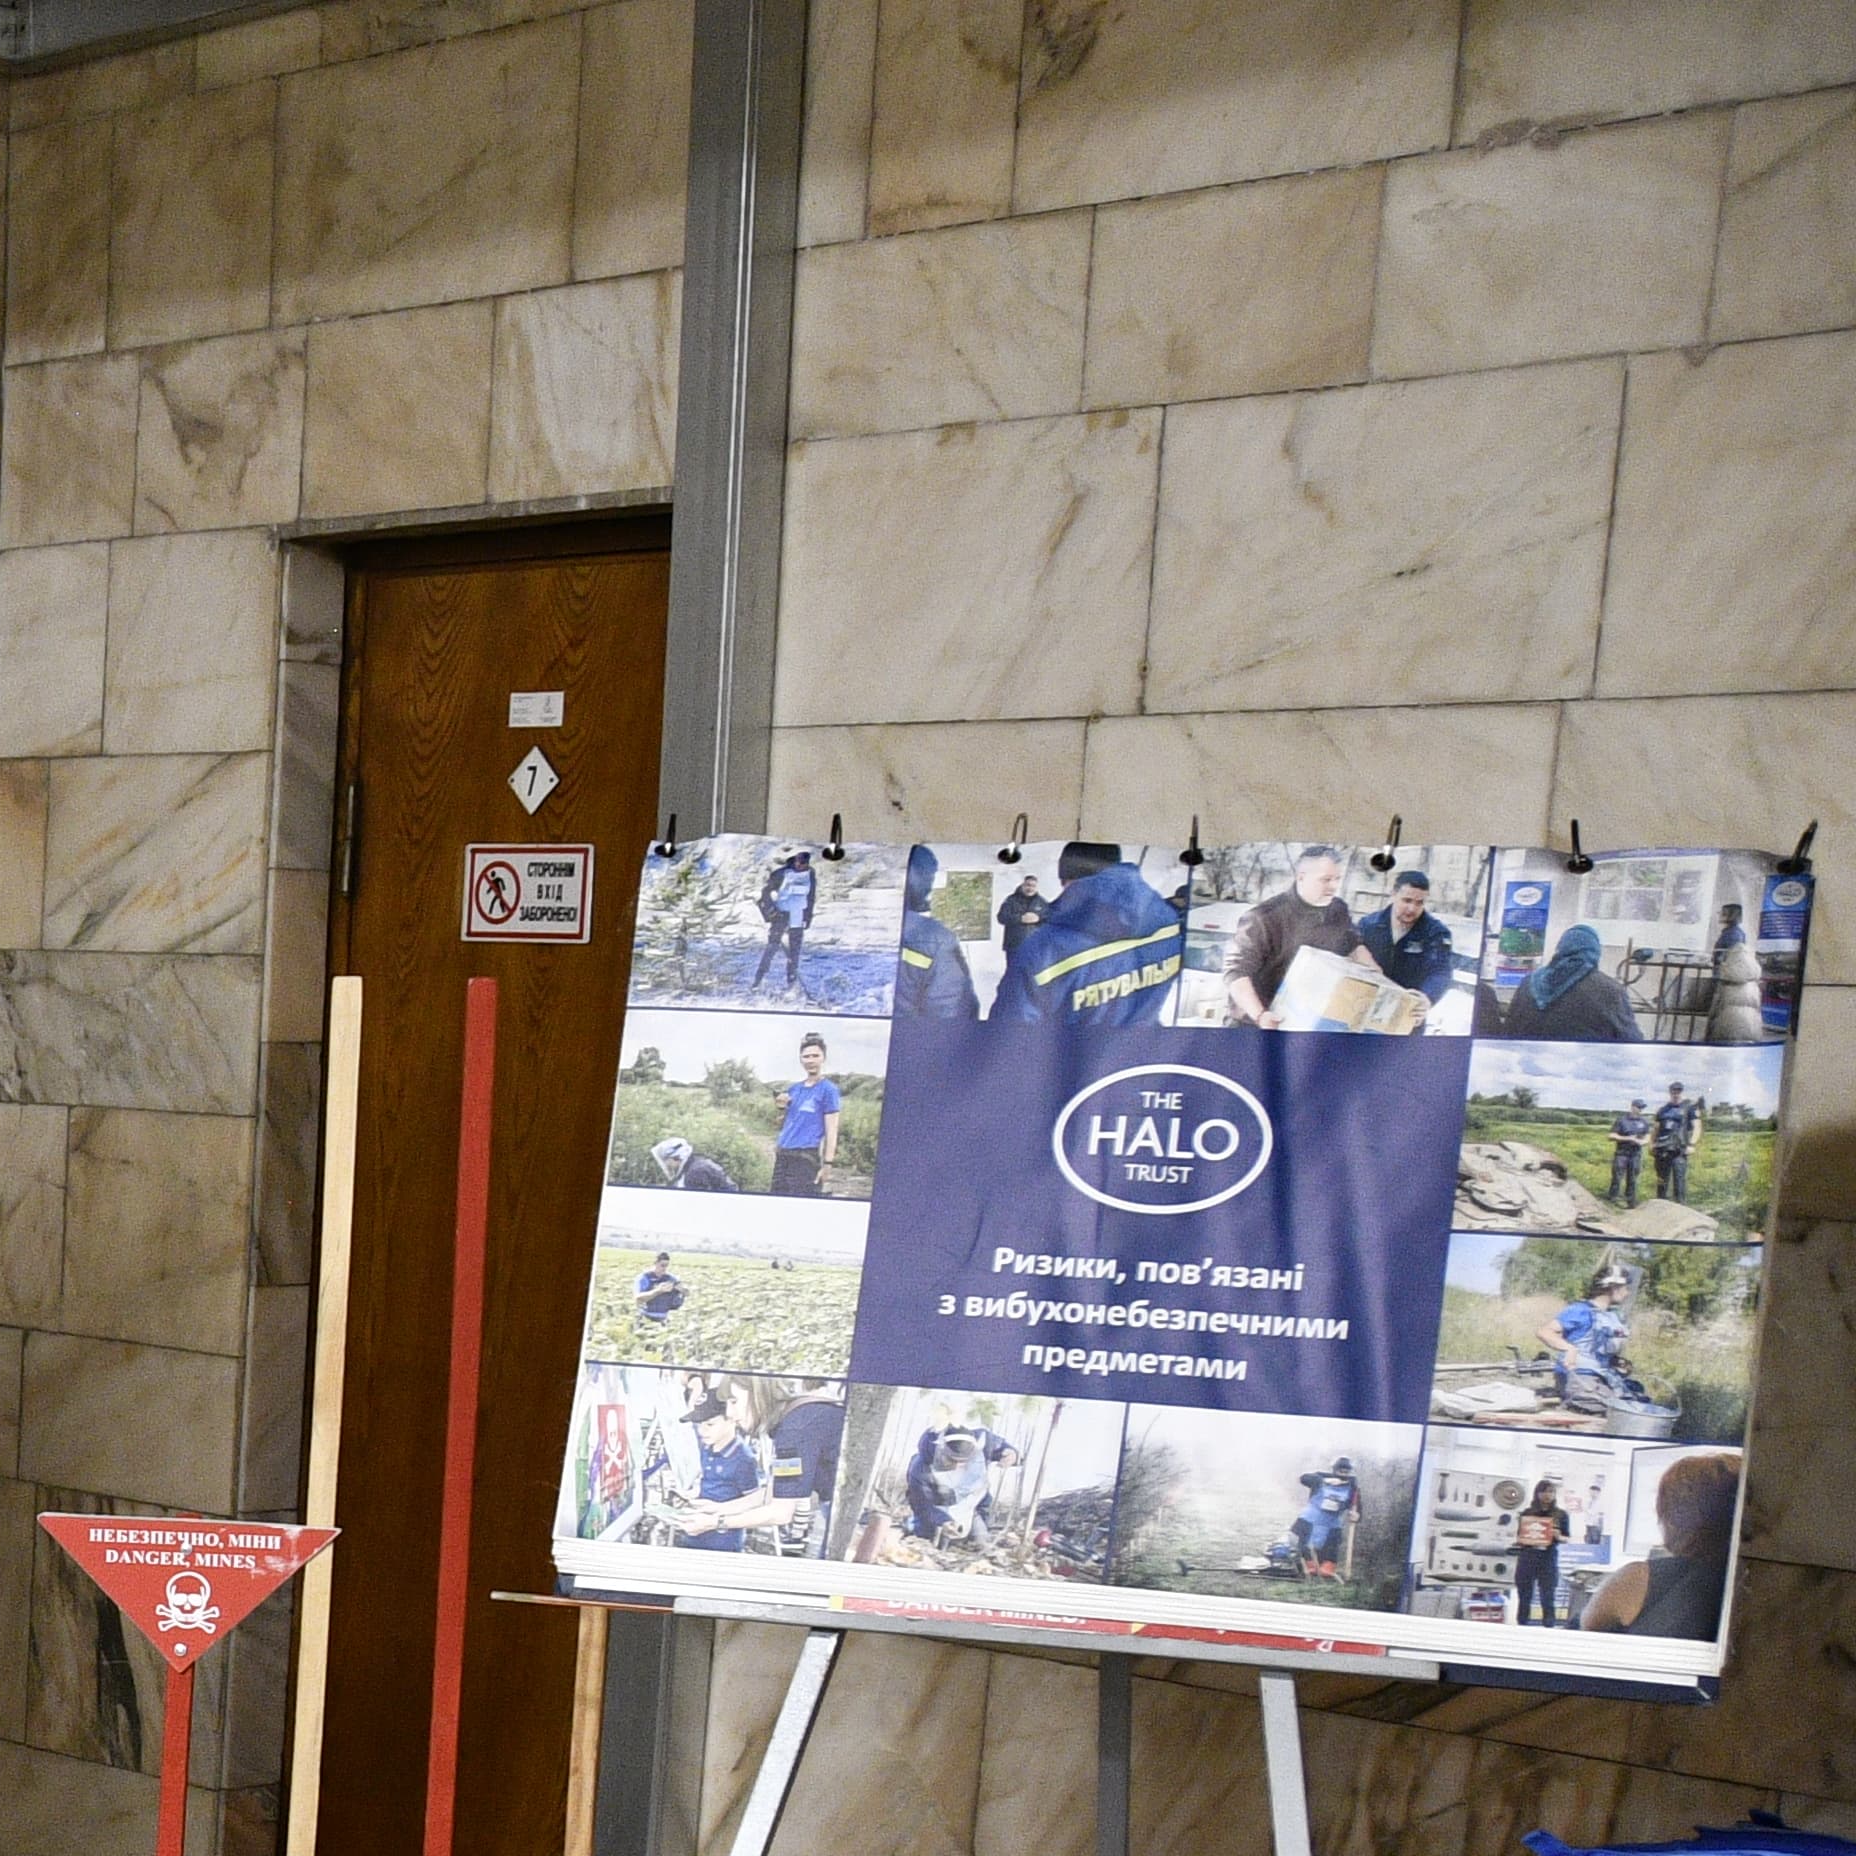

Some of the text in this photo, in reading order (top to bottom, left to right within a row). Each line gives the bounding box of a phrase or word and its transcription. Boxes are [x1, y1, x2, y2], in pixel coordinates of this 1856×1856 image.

[526, 765, 538, 797] 7
[536, 883, 563, 902] ВХІД
[1139, 1091, 1184, 1111] THE
[1087, 1114, 1240, 1161] HALO
[1123, 1163, 1194, 1185] TRUST
[992, 1247, 1127, 1286] Ризики,
[938, 1290, 1350, 1341] з вибухонебезпечними
[1021, 1344, 1248, 1382] предметами
[88, 1528, 282, 1550] НЕБЕЗПЕЧНО, МІНИ
[105, 1549, 256, 1570] DANGER, MINES
